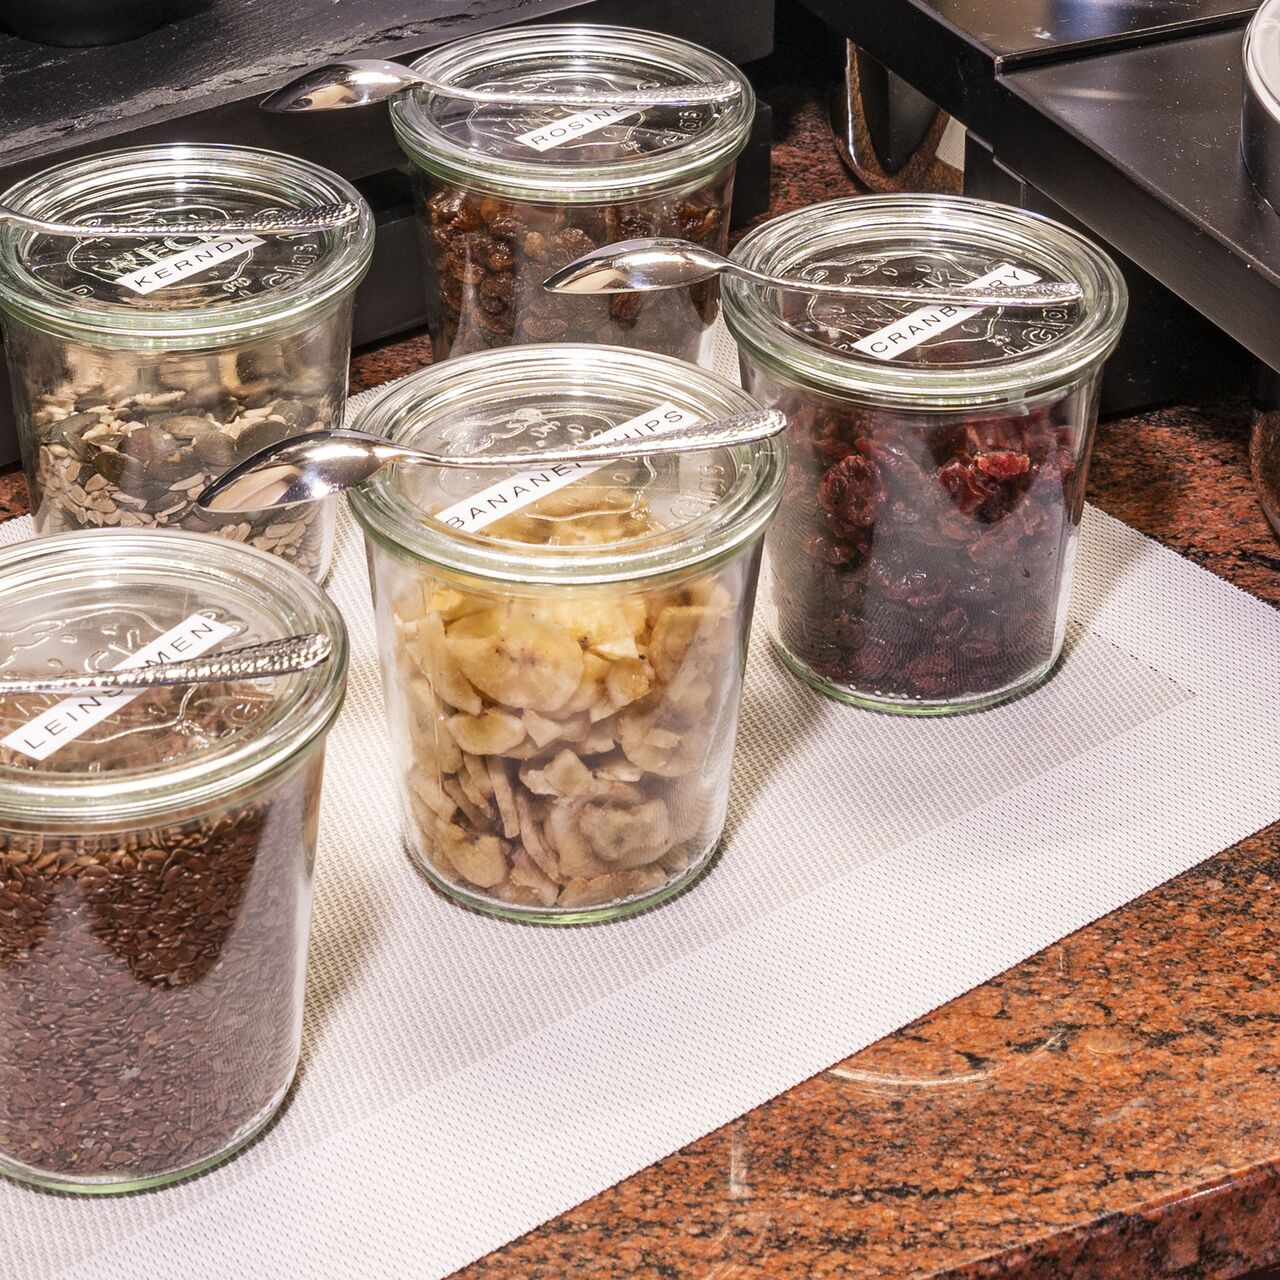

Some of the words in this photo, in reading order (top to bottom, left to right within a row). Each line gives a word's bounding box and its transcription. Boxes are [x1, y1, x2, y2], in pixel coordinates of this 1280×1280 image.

[530, 105, 629, 146] ROSINE
[133, 236, 255, 288] KERNDL
[869, 270, 1020, 354] CRANBRY
[446, 409, 684, 530] BANANEHIPS
[23, 622, 214, 750] LEINSMEN
